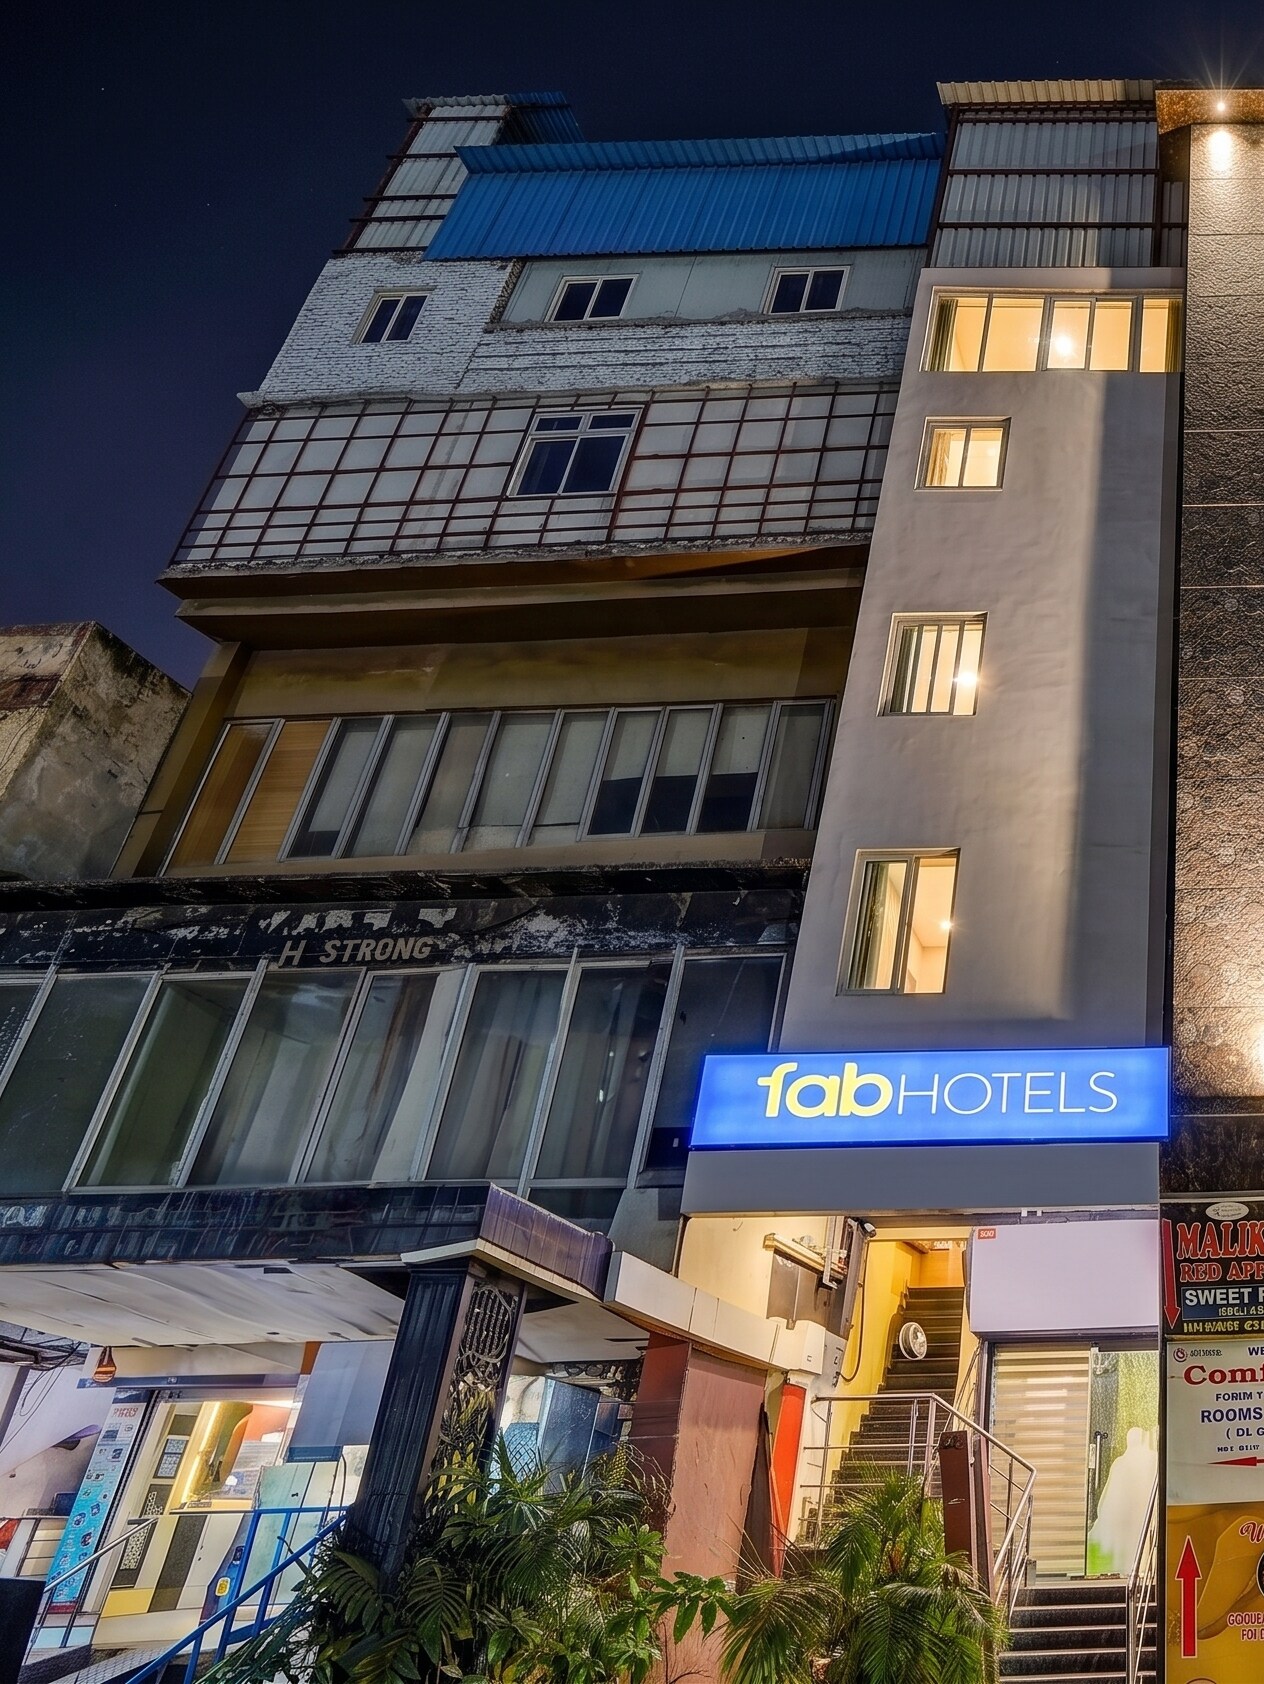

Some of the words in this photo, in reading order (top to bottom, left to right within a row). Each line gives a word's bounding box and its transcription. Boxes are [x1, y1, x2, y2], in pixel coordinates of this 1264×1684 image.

[319, 937, 433, 964] STRONG
[1180, 1261, 1223, 1283] RED
[1185, 1288, 1252, 1306] SWEET
[1200, 1406, 1263, 1424] ROOMS
